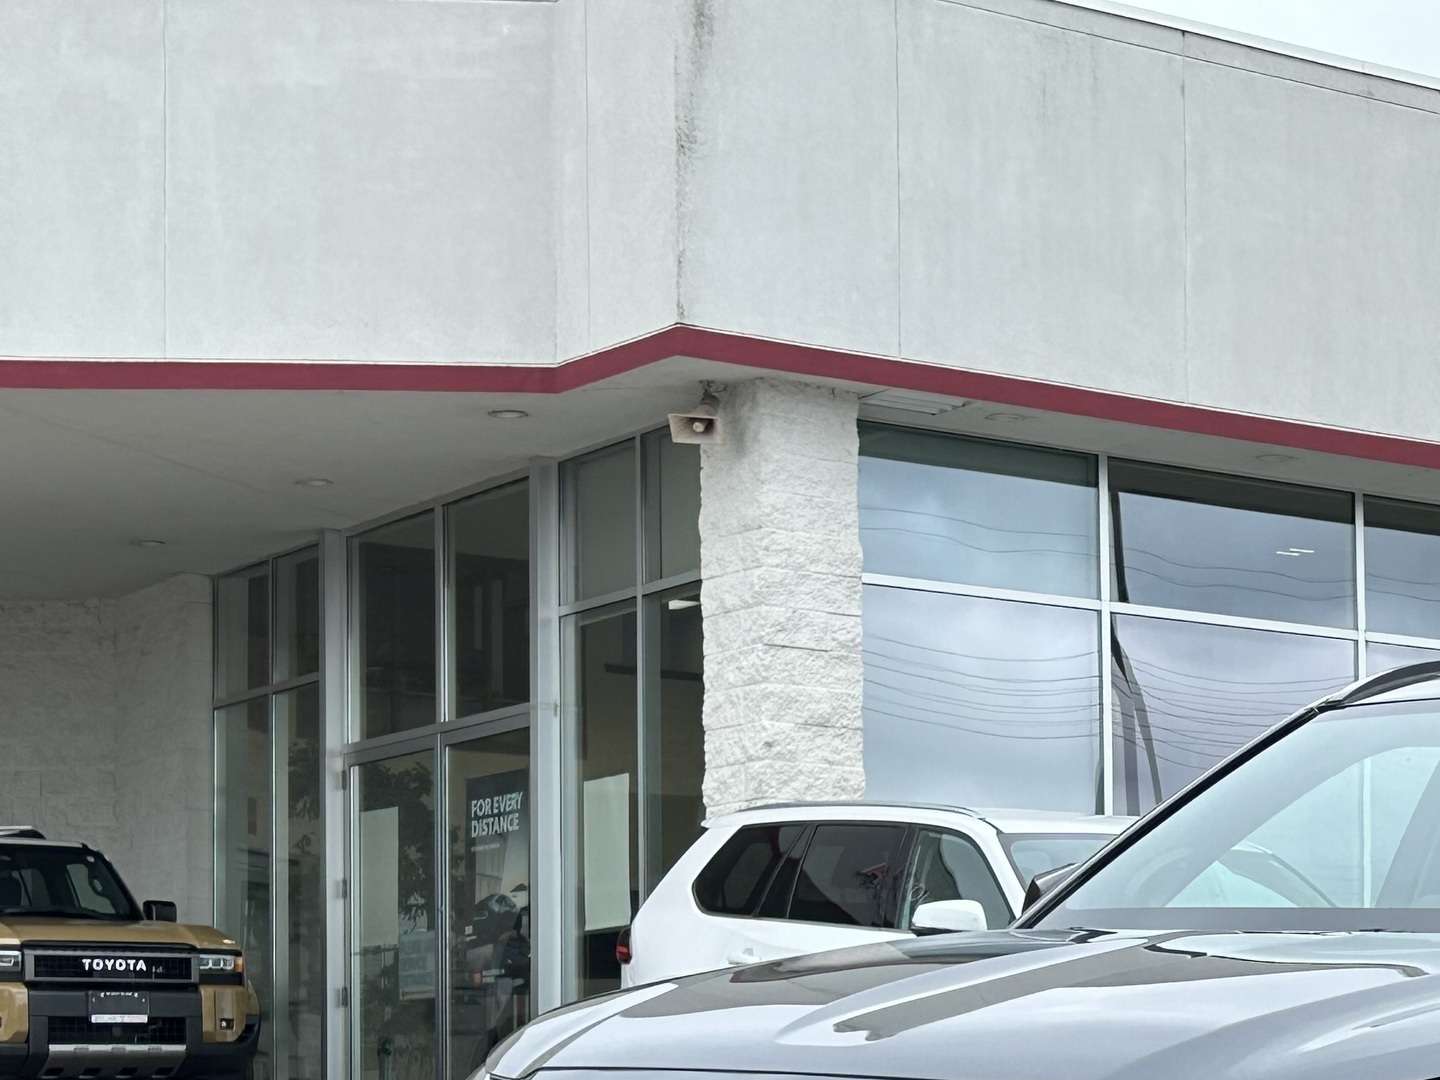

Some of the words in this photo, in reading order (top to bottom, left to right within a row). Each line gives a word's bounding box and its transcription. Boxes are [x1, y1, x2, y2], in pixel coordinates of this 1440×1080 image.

[471, 798, 492, 818] FOR
[493, 791, 523, 814] EVERY
[471, 812, 520, 838] DISTANCE
[82, 958, 147, 972] TOYOTA
